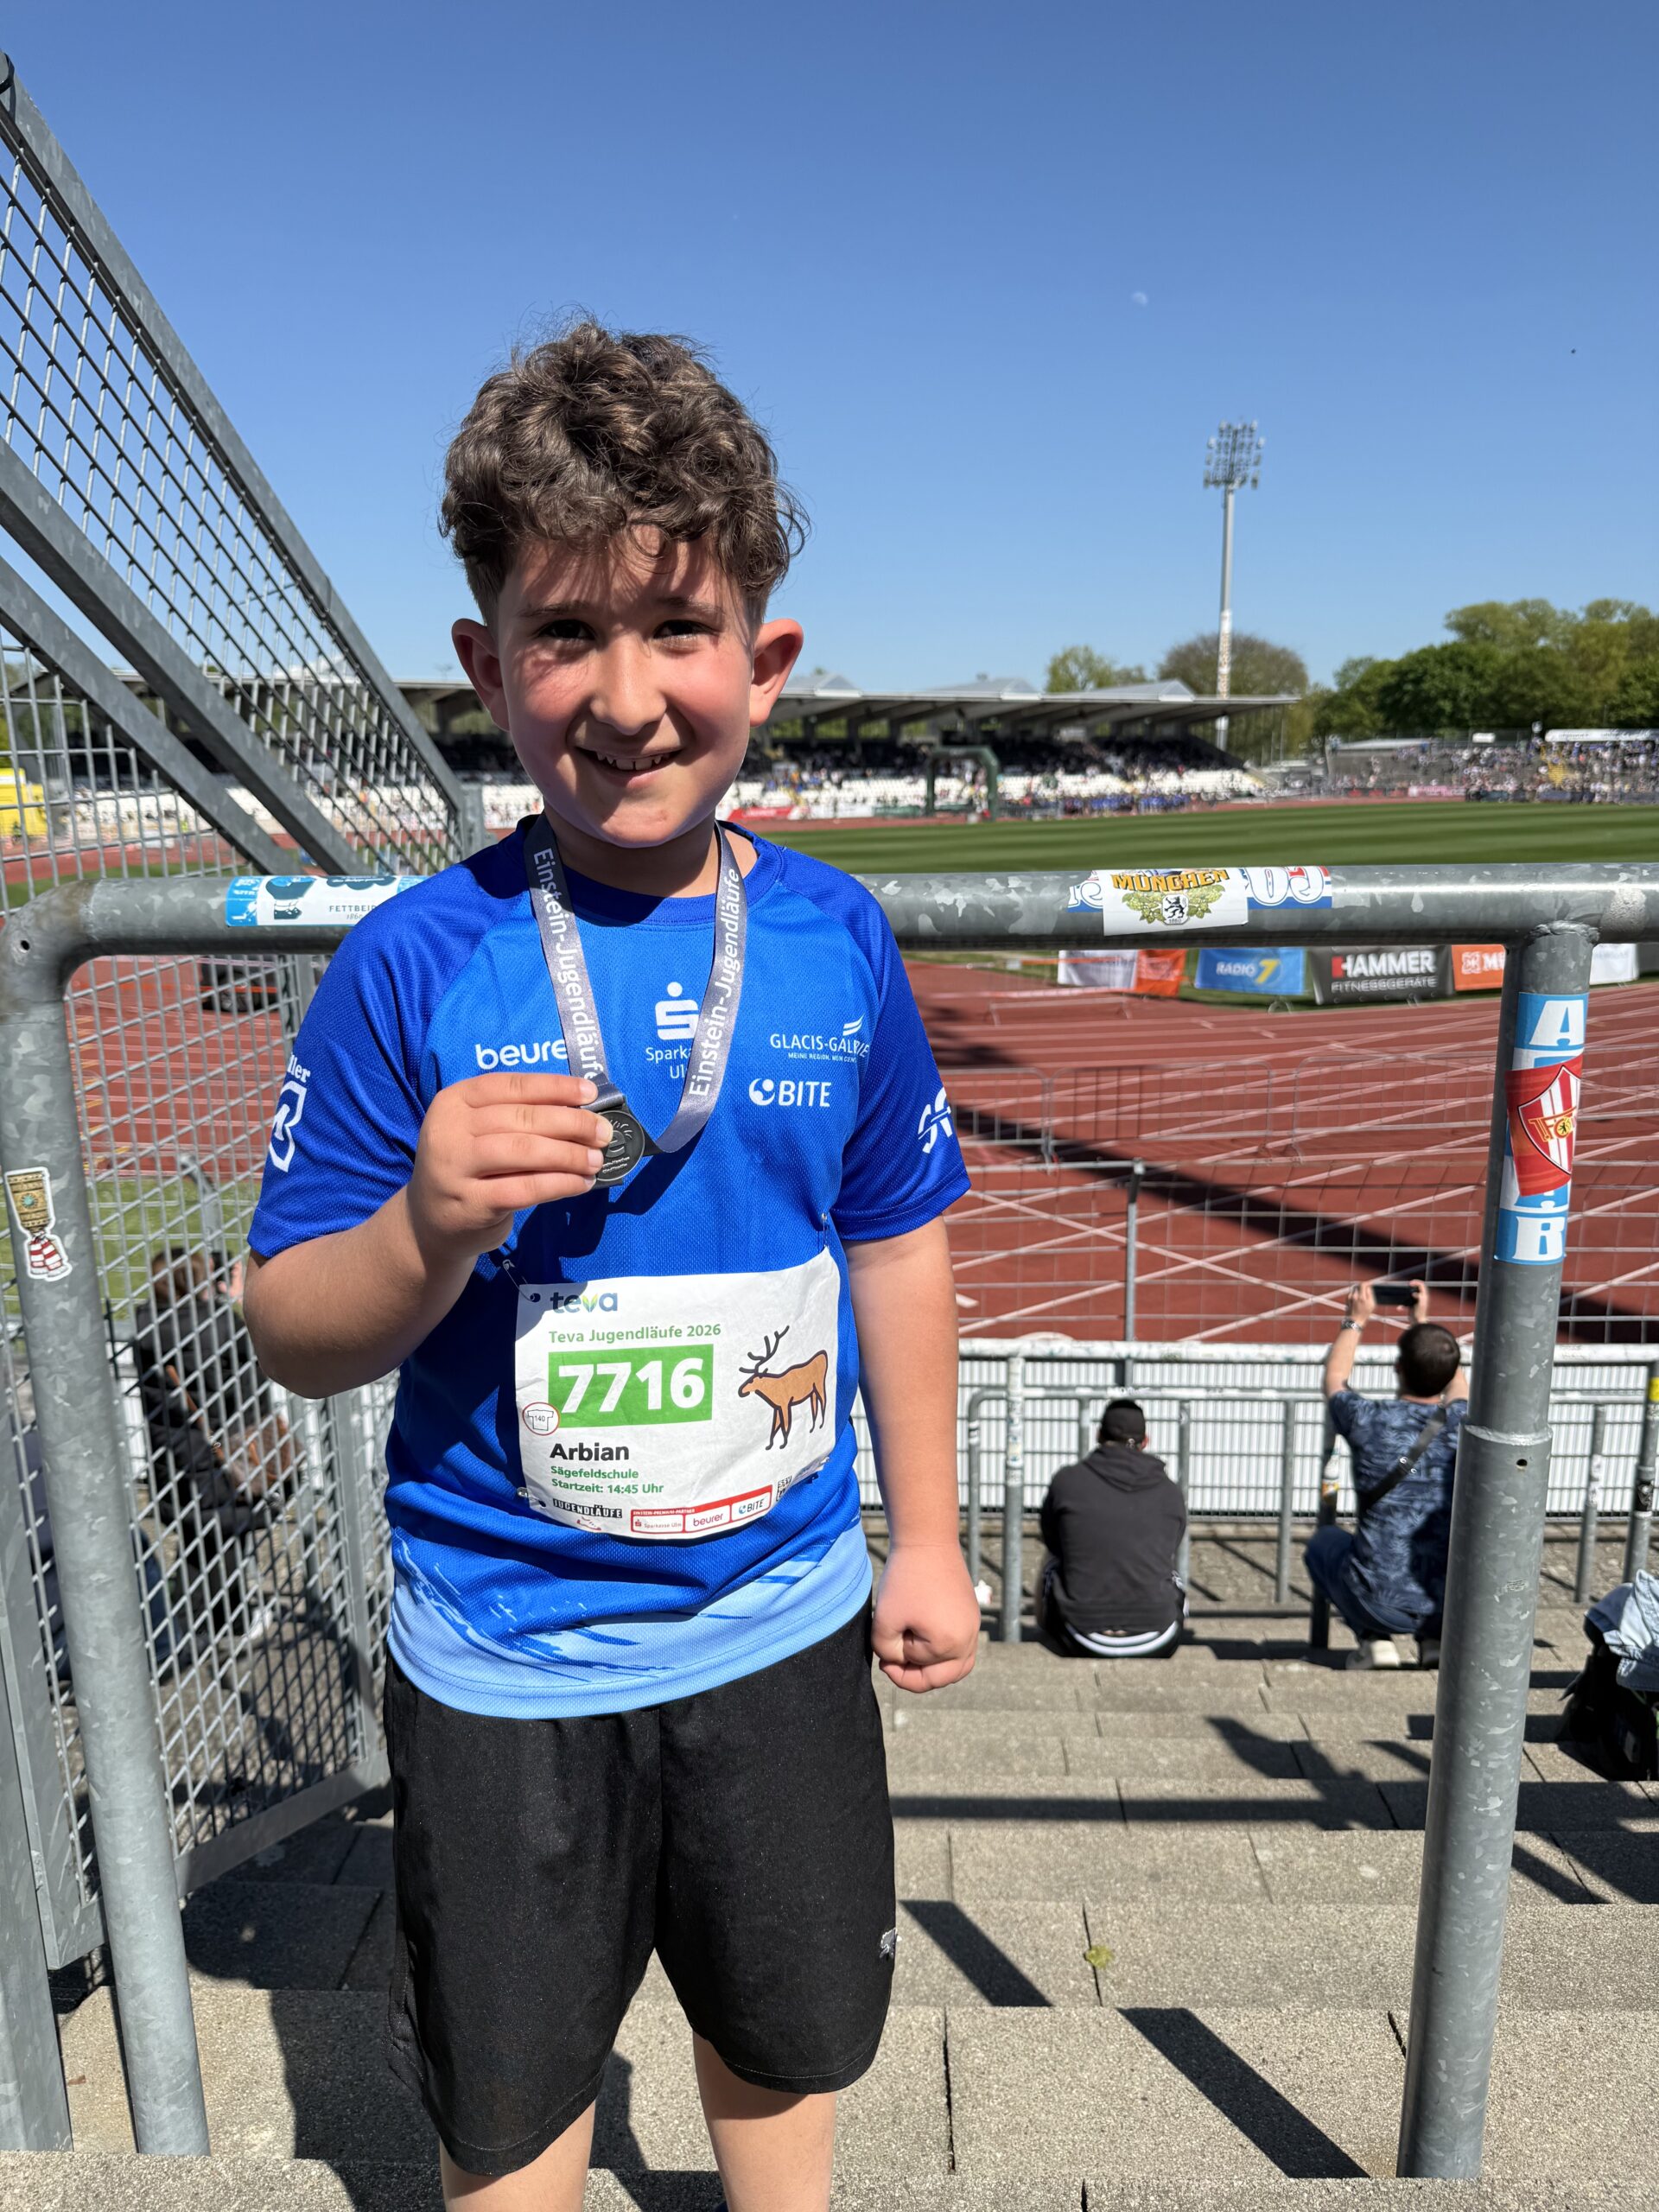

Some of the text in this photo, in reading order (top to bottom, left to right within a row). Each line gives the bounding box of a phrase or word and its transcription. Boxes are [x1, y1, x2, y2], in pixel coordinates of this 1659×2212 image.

[1216, 958, 1281, 985] RADIO 7
[1332, 950, 1437, 978] HAMMER
[689, 868, 741, 1096] Einstein-Jugendläufe
[475, 1039, 569, 1070] beure
[779, 1080, 832, 1107] BITE
[550, 1292, 618, 1314] teva
[549, 1324, 721, 1344] Teva Jugendläufe 2026
[558, 1357, 705, 1414] 7716
[550, 1442, 629, 1461] Arbian
[550, 1465, 639, 1478] Sägefeldschule
[551, 1478, 664, 1494] Startzeit: 14:45 Uhr
[553, 1498, 623, 1518] JUGENDLÄUFE
[747, 1499, 765, 1513] BITE
[693, 1513, 724, 1527] beurer
